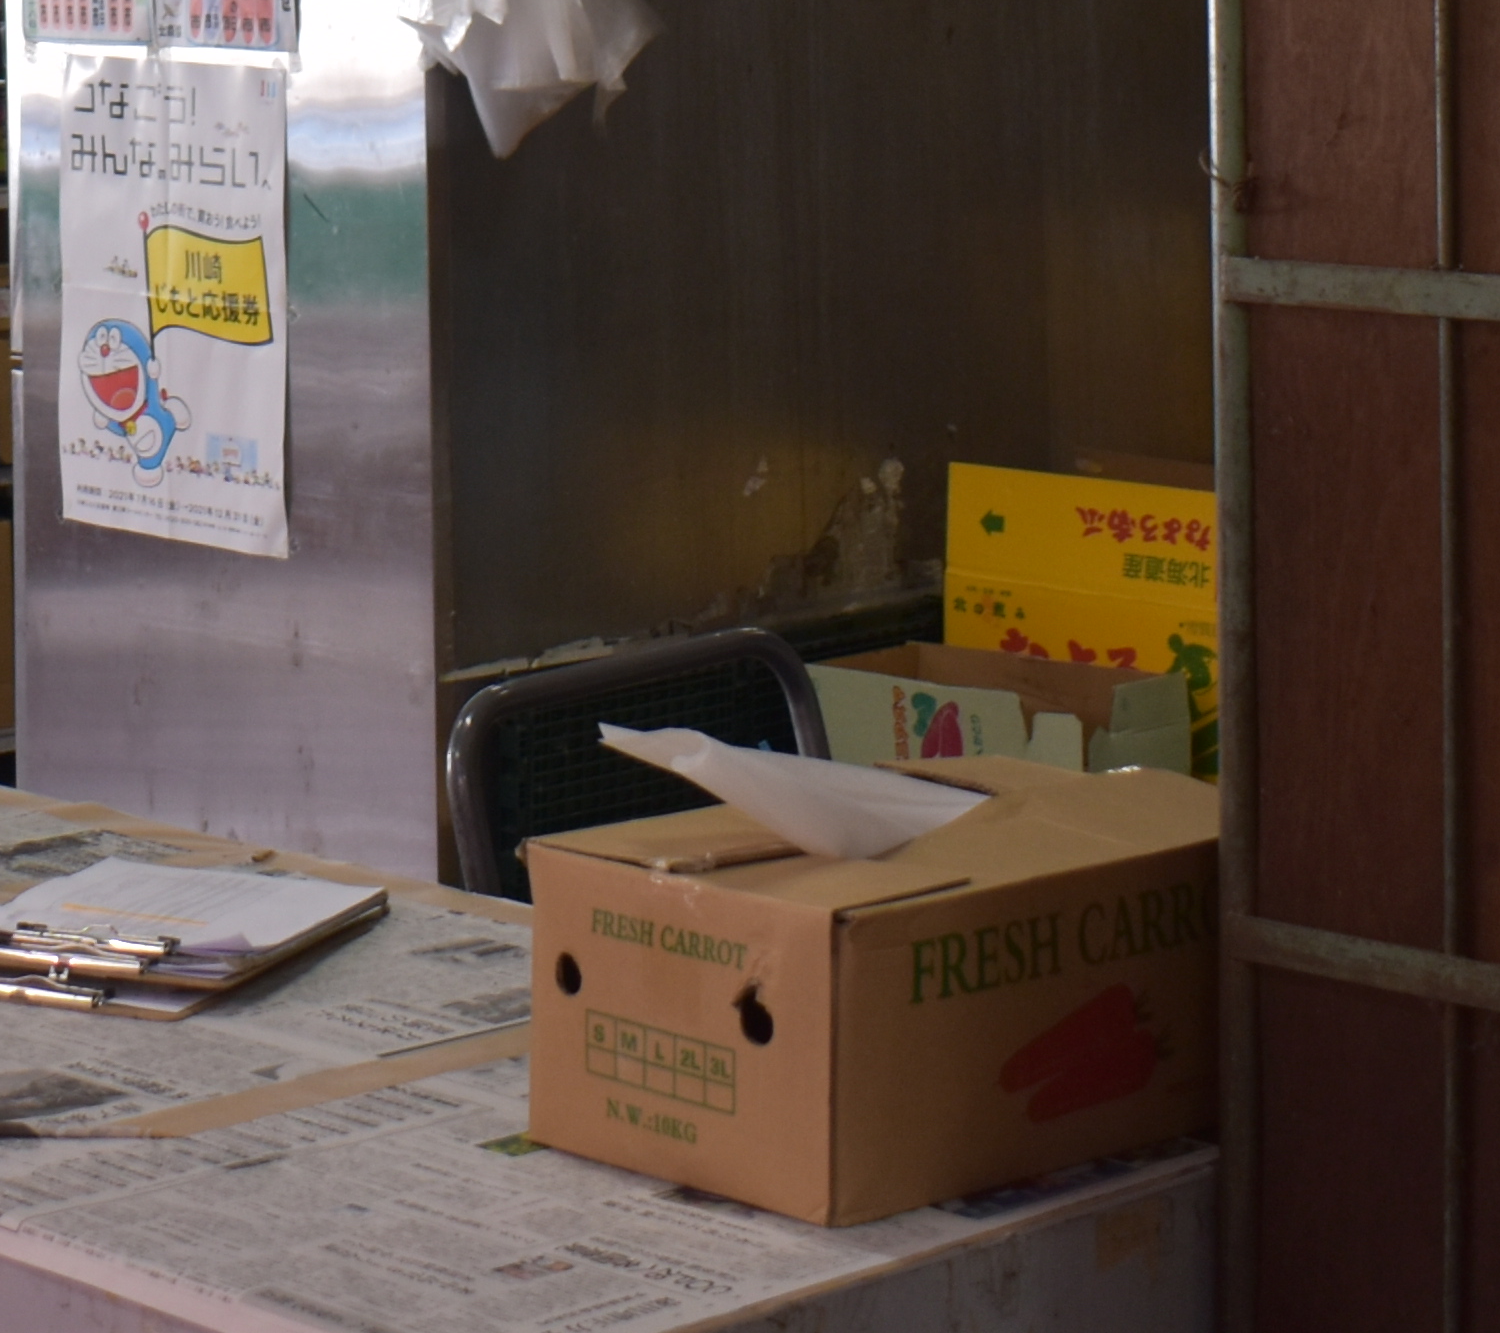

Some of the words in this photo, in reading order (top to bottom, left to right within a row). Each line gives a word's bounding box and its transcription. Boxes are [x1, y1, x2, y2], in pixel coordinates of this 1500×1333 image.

[185, 251, 222, 284] 川崎
[155, 285, 260, 326] じもと応援券
[1076, 507, 1210, 551] なよろ南瓜
[1123, 553, 1210, 588] 北海道産
[591, 909, 654, 951] FRESH
[660, 916, 747, 971] CARROT
[912, 914, 1063, 1003] FRESH
[593, 1023, 605, 1044] S
[621, 1033, 638, 1054] M
[655, 1043, 665, 1063] L
[680, 1049, 700, 1072] 2L
[710, 1056, 731, 1079] 3L
